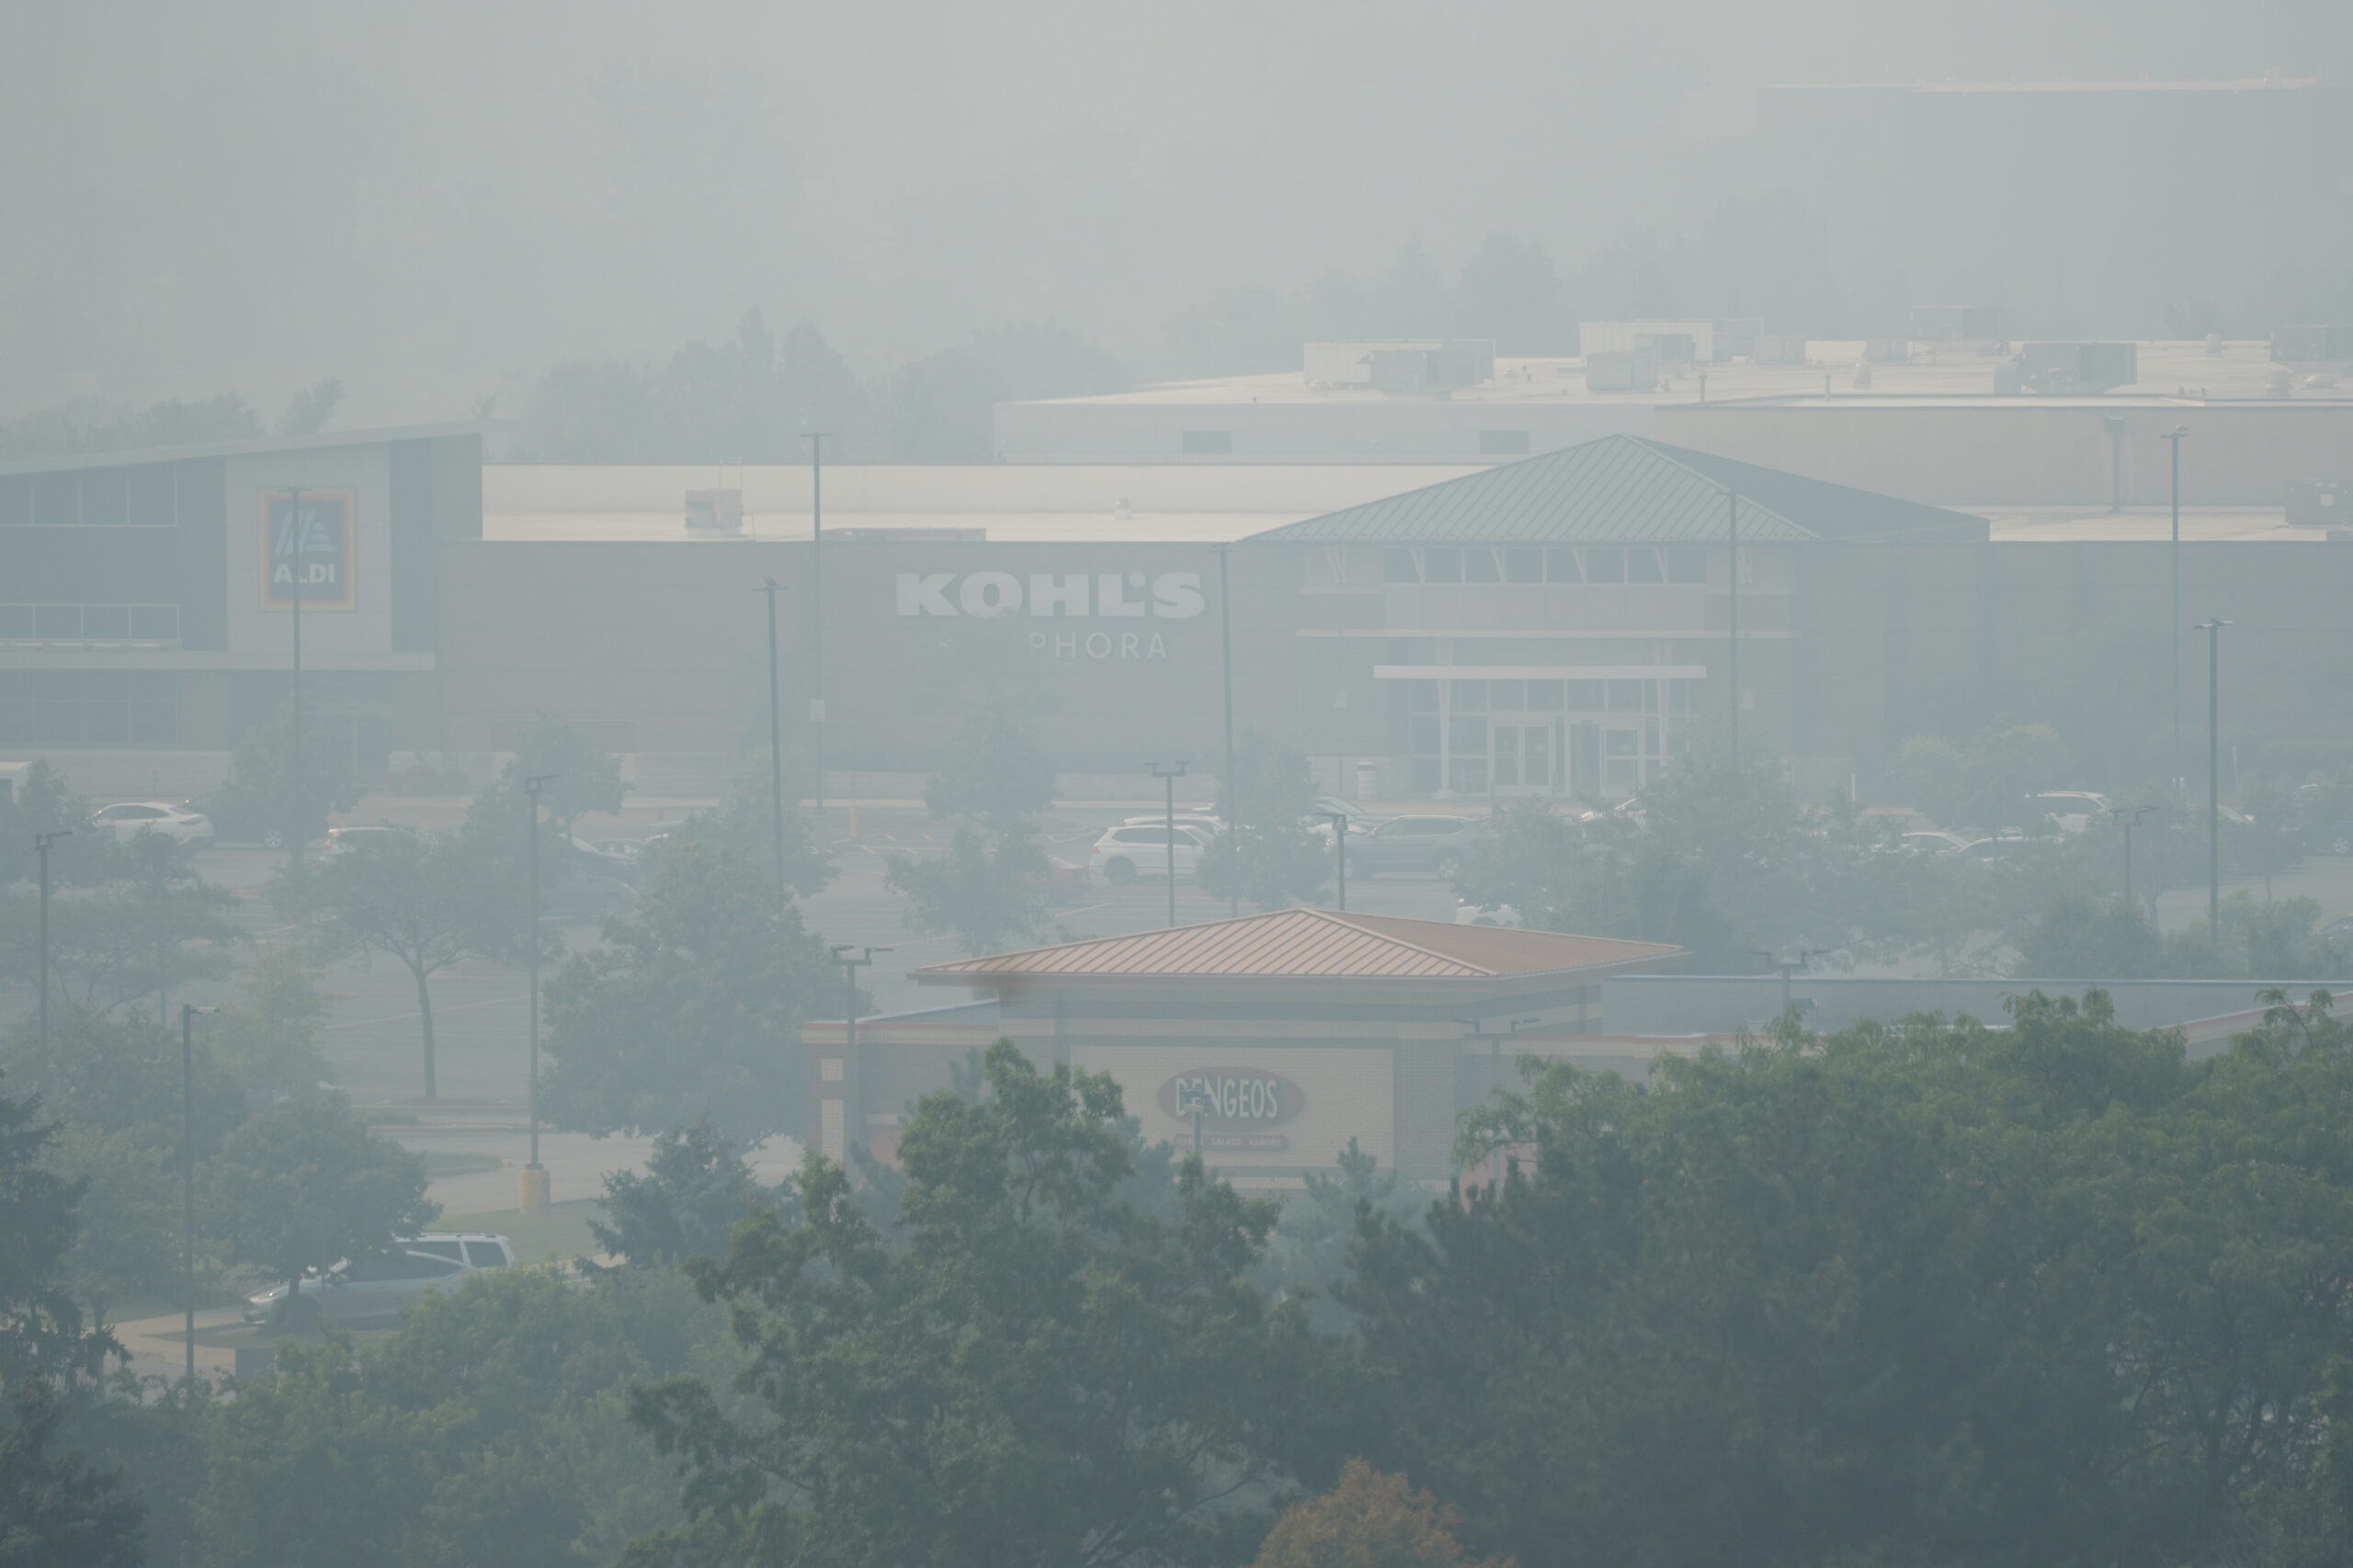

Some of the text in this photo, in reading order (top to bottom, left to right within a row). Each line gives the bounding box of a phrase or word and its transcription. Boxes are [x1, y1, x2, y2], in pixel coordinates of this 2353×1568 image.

[896, 571, 1206, 619] KOHL'S
[1029, 631, 1168, 660] PHORA
[1177, 1138, 1204, 1148] GYRS
